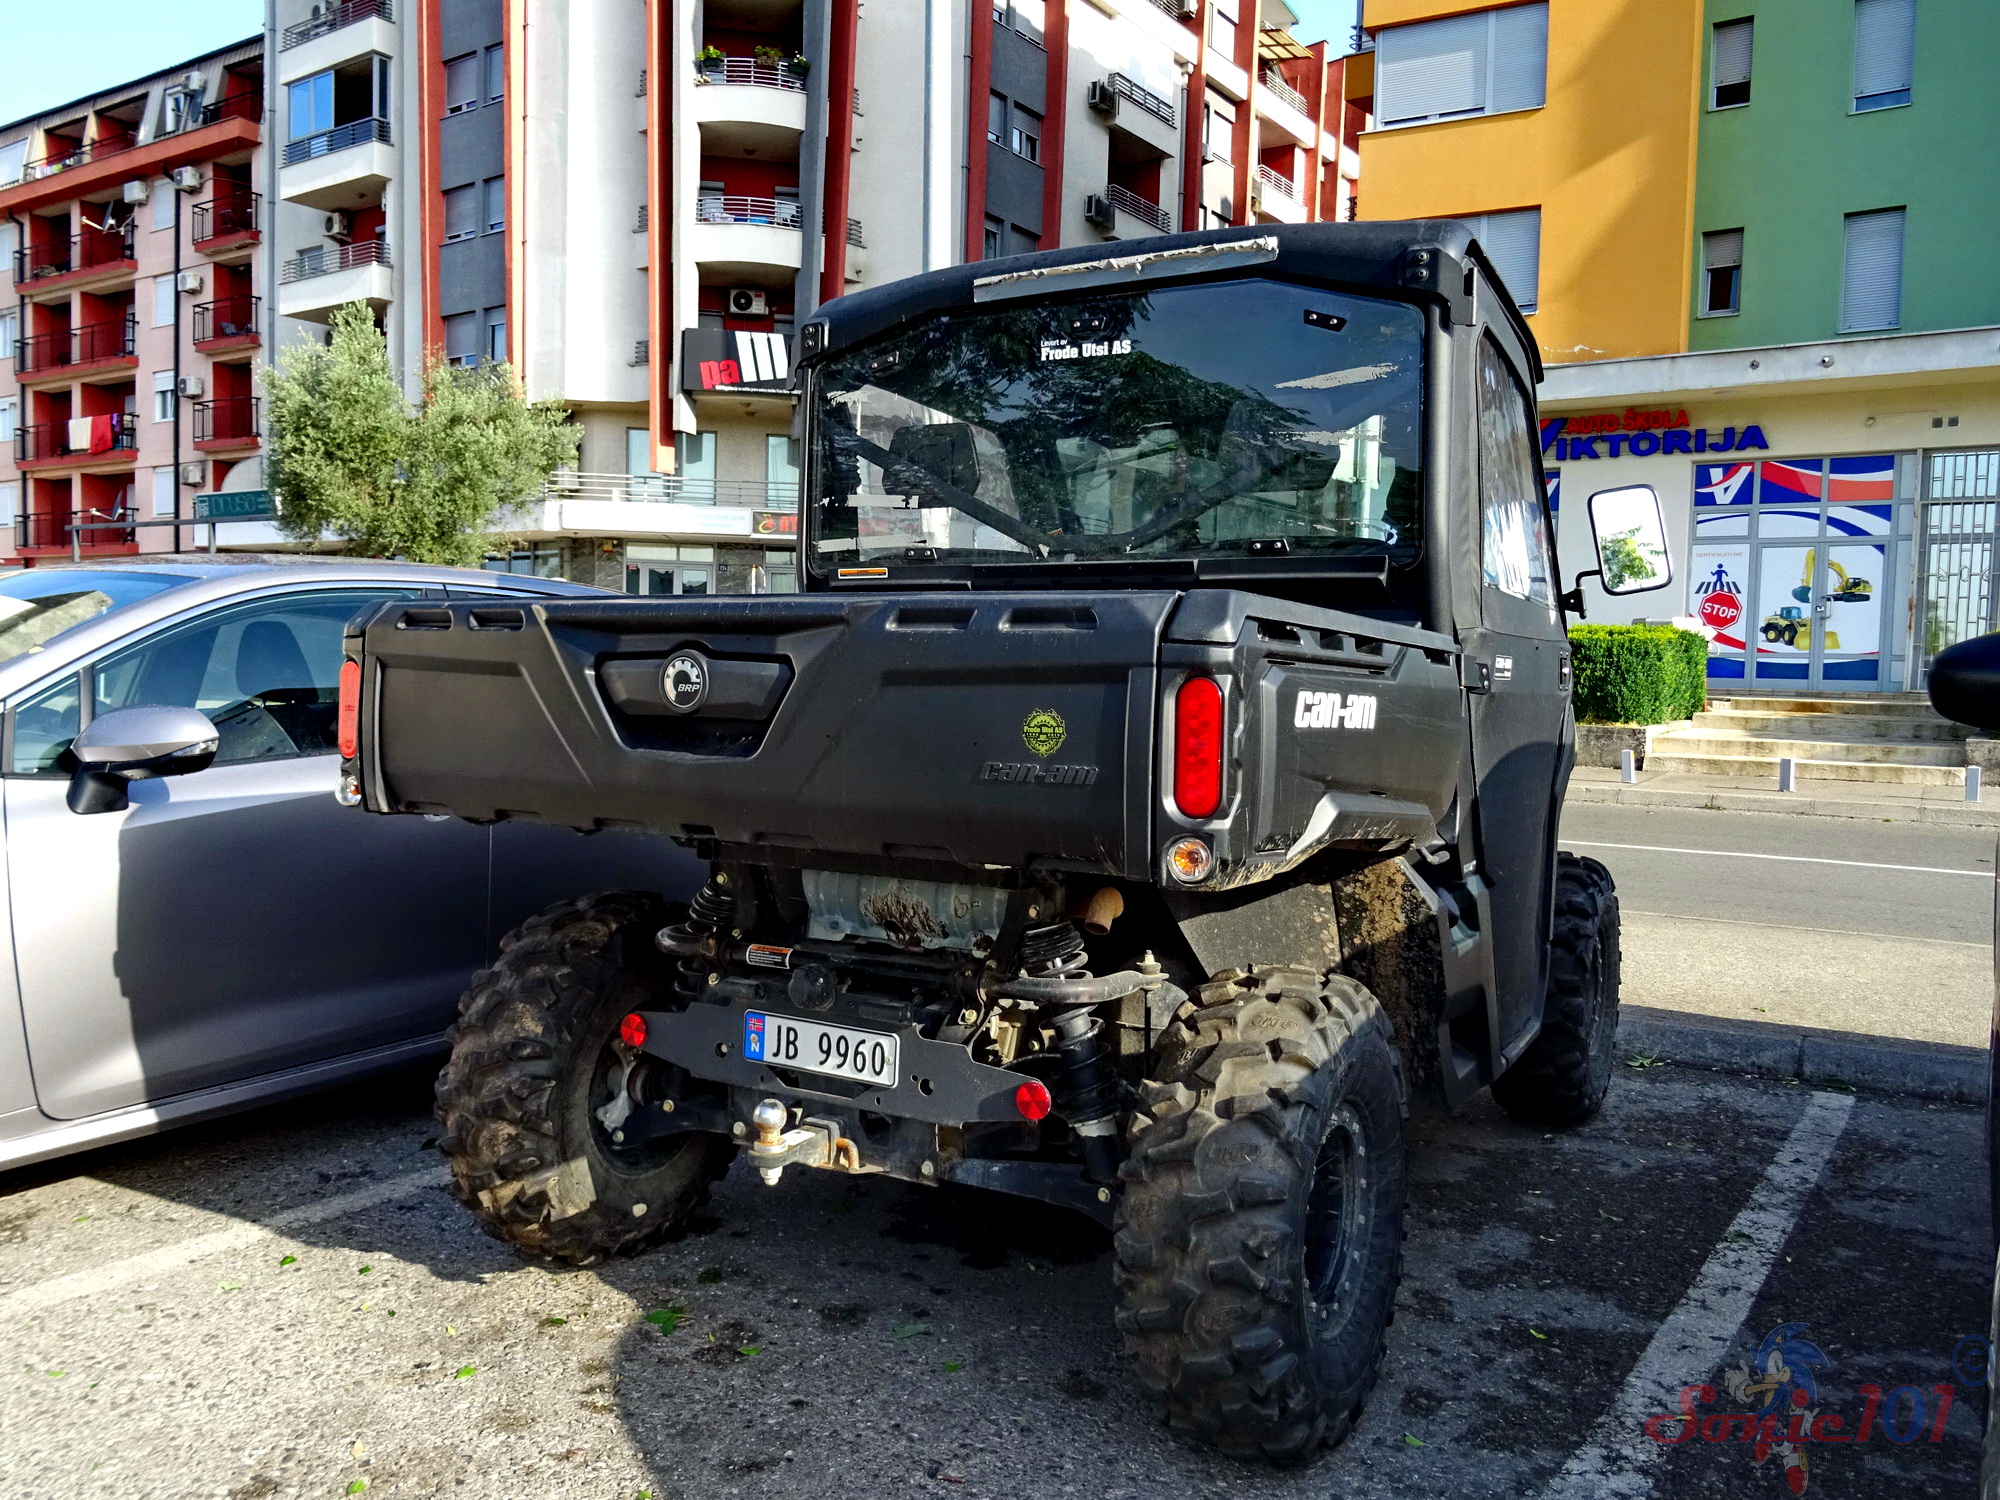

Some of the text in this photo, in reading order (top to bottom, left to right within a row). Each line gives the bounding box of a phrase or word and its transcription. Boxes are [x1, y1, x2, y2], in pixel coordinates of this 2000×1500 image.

[1041, 339, 1131, 361] Frode Utsi AS
[1567, 408, 1690, 434] AUTO ŠKOLA
[1703, 602, 1737, 619] STOP
[678, 683, 700, 693] BRP
[772, 1024, 886, 1076] JB 9960
